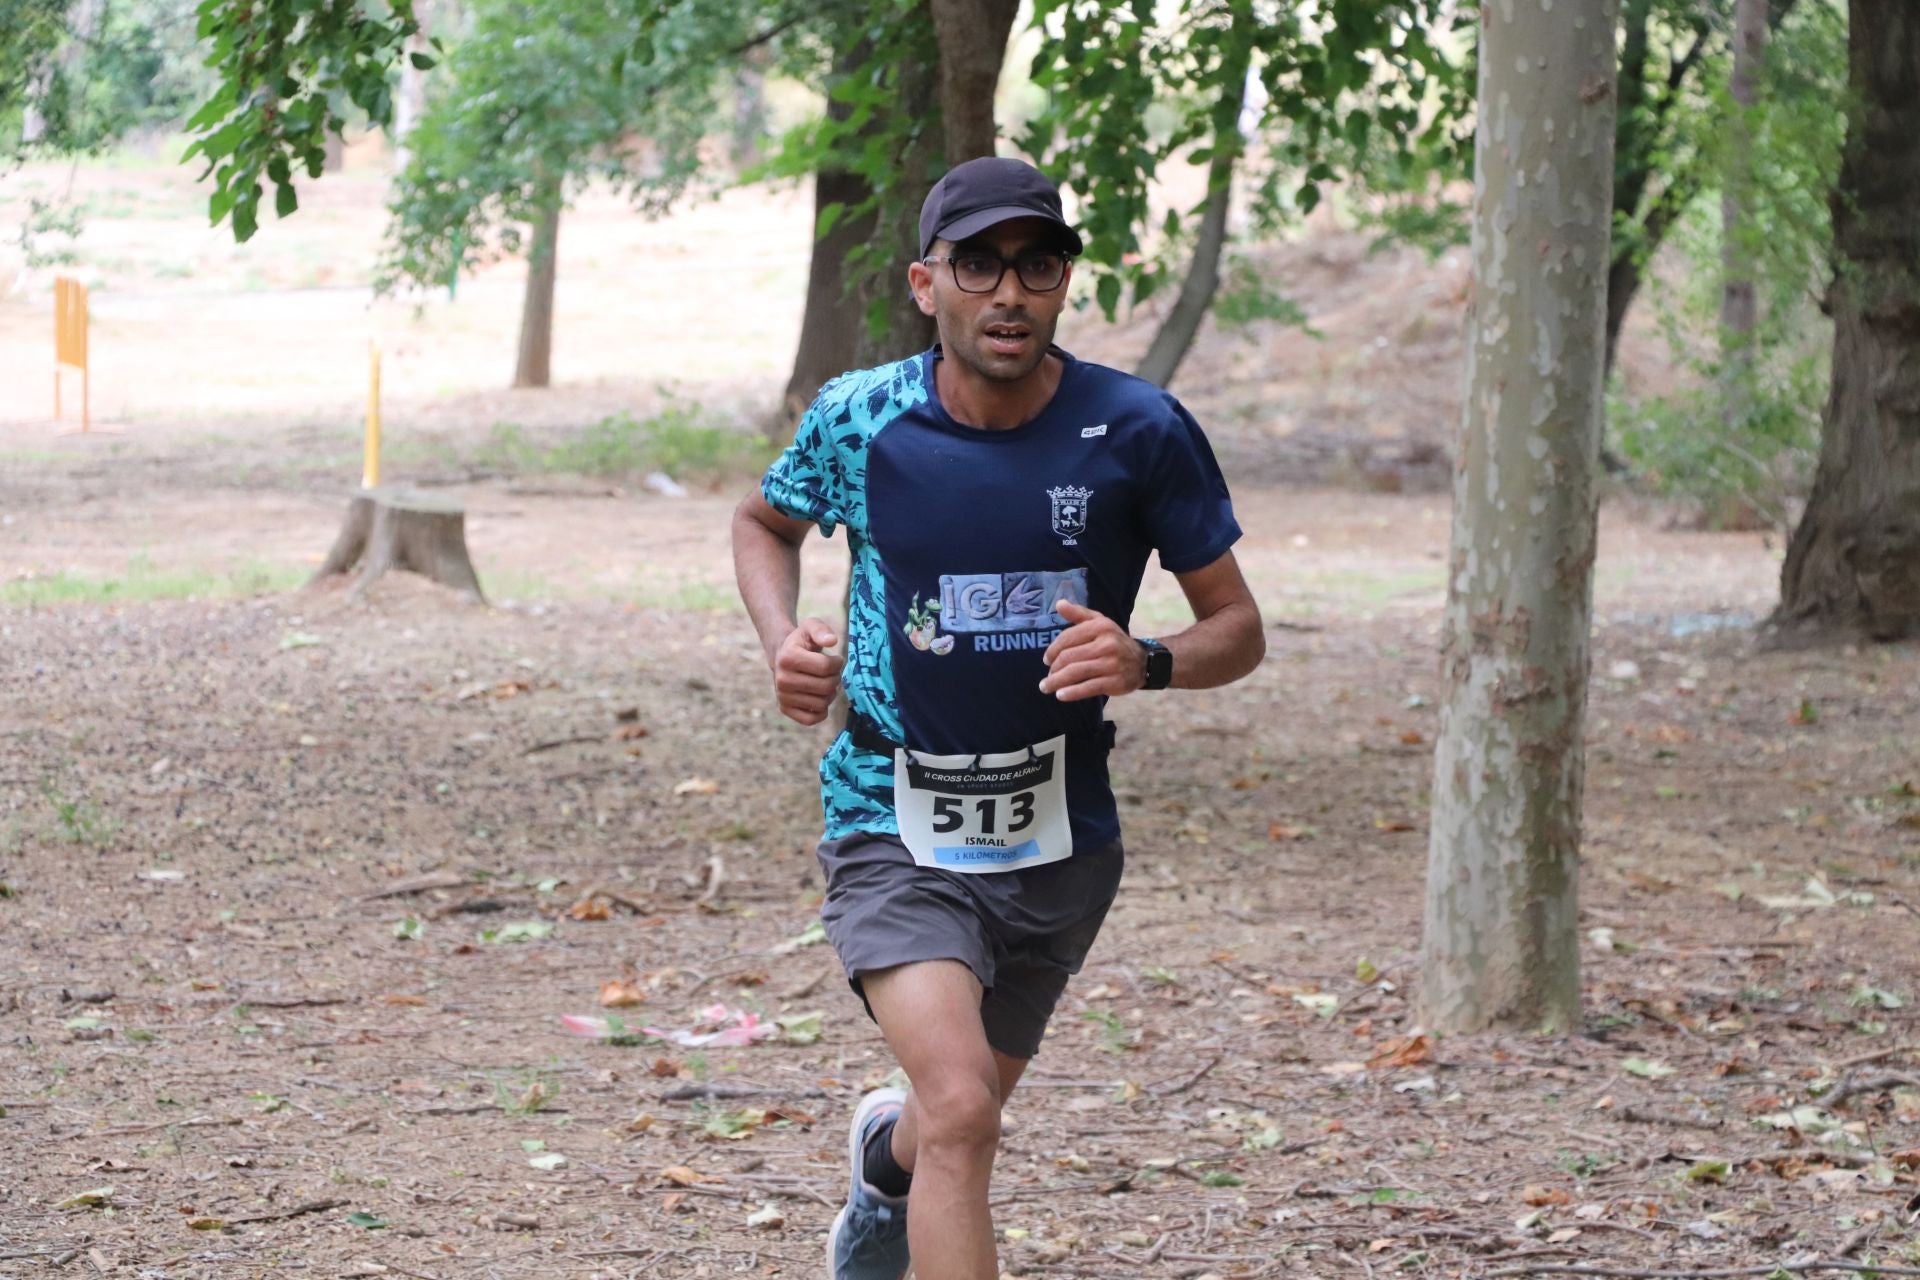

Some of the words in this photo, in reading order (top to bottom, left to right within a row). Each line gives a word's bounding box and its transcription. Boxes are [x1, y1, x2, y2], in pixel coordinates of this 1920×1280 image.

[931, 773, 962, 782] CROSS
[963, 773, 998, 782] CIUDAD
[999, 772, 1013, 781] DE
[932, 792, 1034, 833] 513
[965, 836, 1007, 847] ISMAIL
[955, 853, 960, 861] 5
